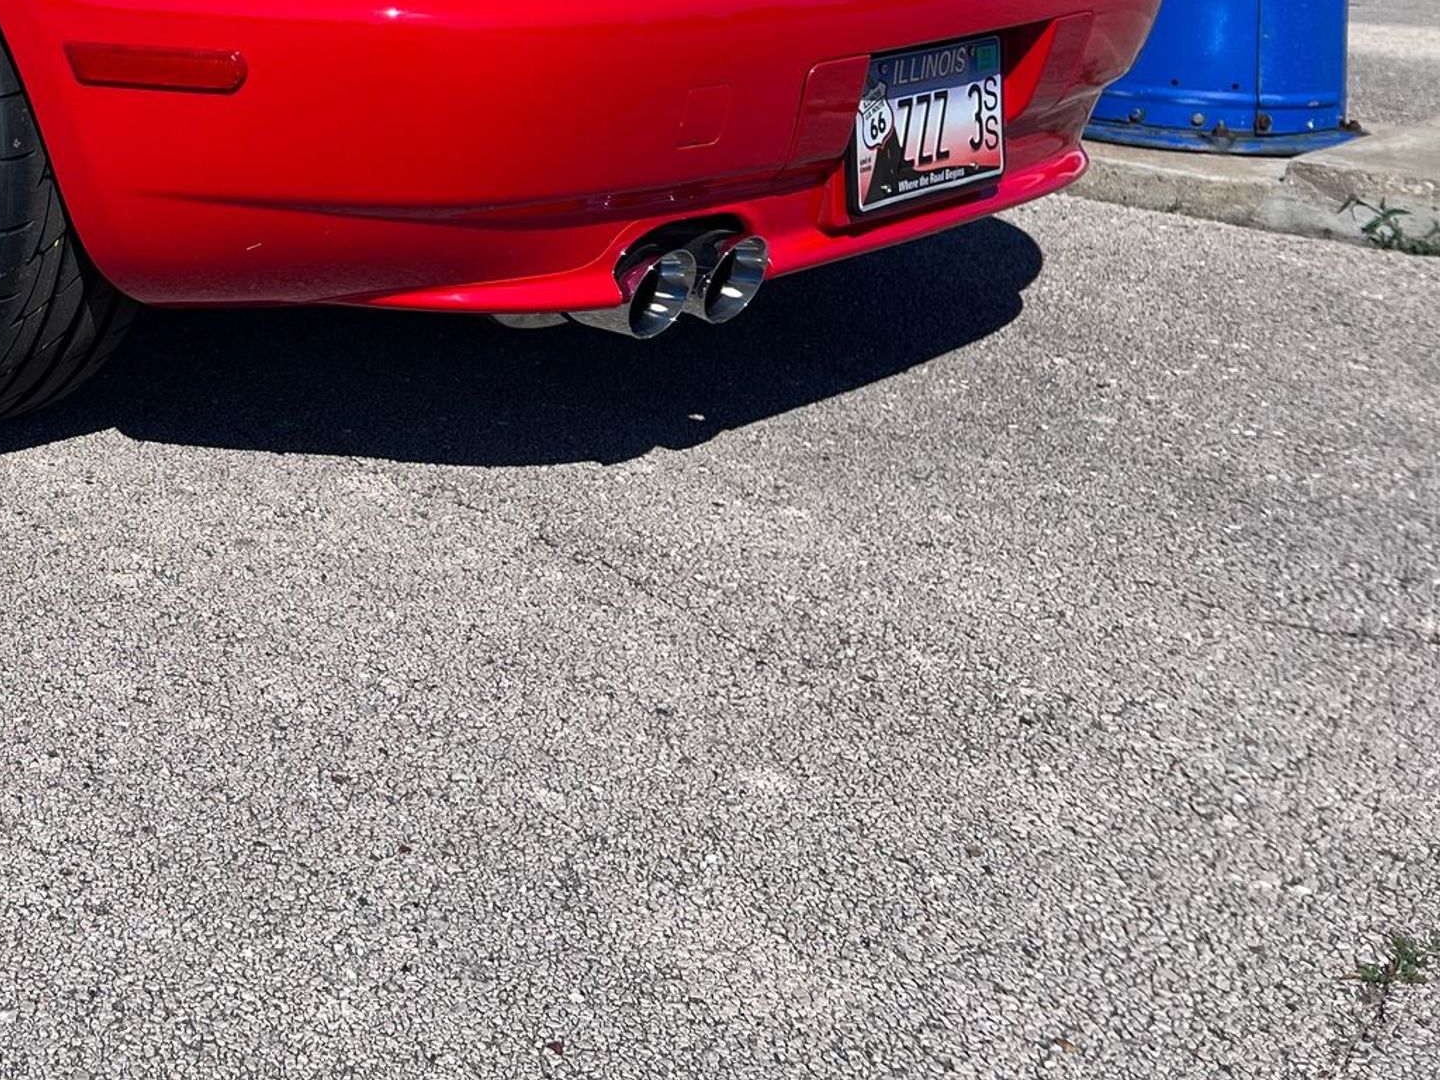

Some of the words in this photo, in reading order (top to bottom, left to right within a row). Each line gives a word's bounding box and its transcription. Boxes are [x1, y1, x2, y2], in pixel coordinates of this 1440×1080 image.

[893, 46, 968, 85] ILLINOIS
[870, 111, 887, 141] 66
[897, 89, 950, 169] ZZZ
[968, 83, 983, 151] 3
[898, 178, 919, 193] Where
[919, 174, 929, 187] the
[930, 170, 945, 184] Road
[945, 167, 965, 182] Begins
